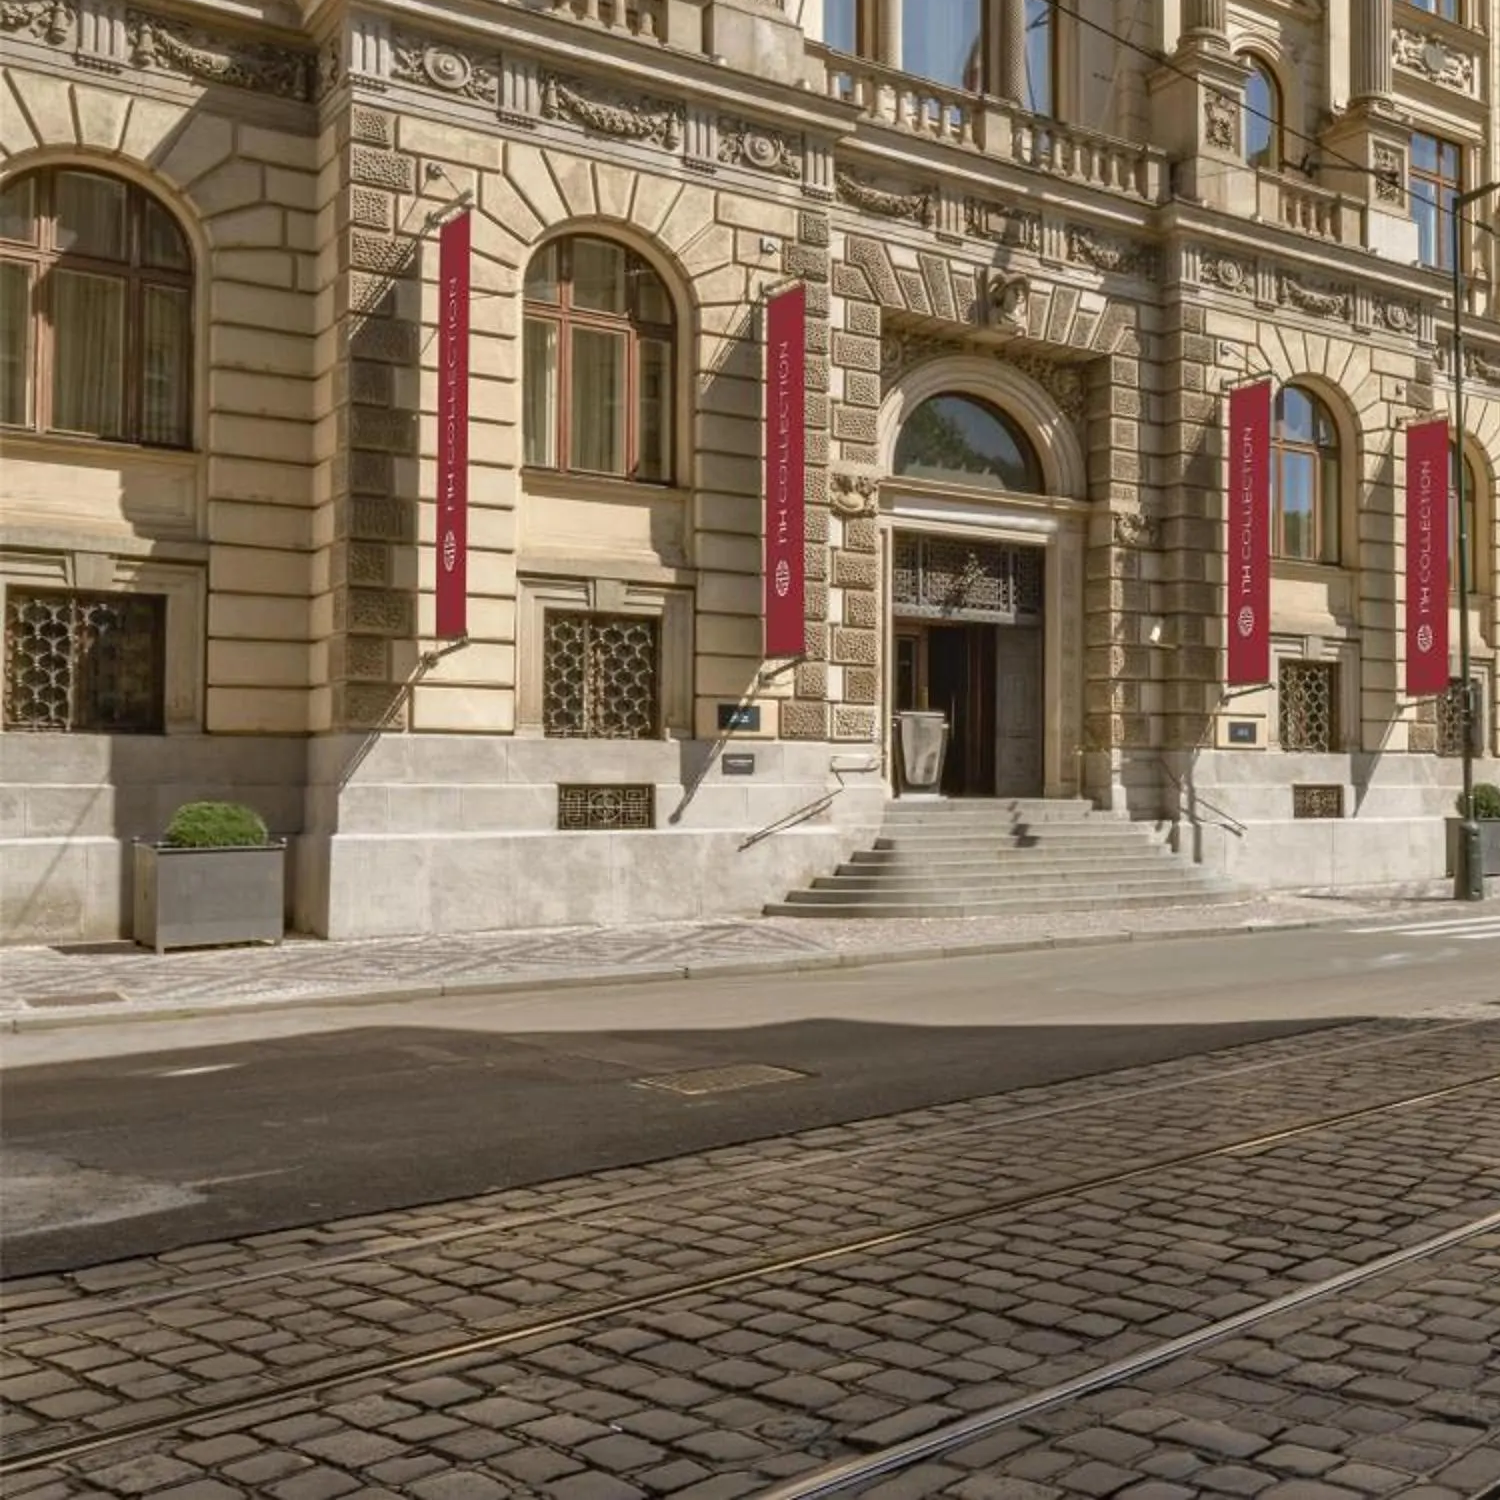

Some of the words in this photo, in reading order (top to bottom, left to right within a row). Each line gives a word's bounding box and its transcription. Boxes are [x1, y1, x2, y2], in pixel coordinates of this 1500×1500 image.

[778, 341, 790, 504] COLLECTION
[1241, 426, 1254, 561] COLLECTION
[1419, 459, 1432, 583] COLLECTION
